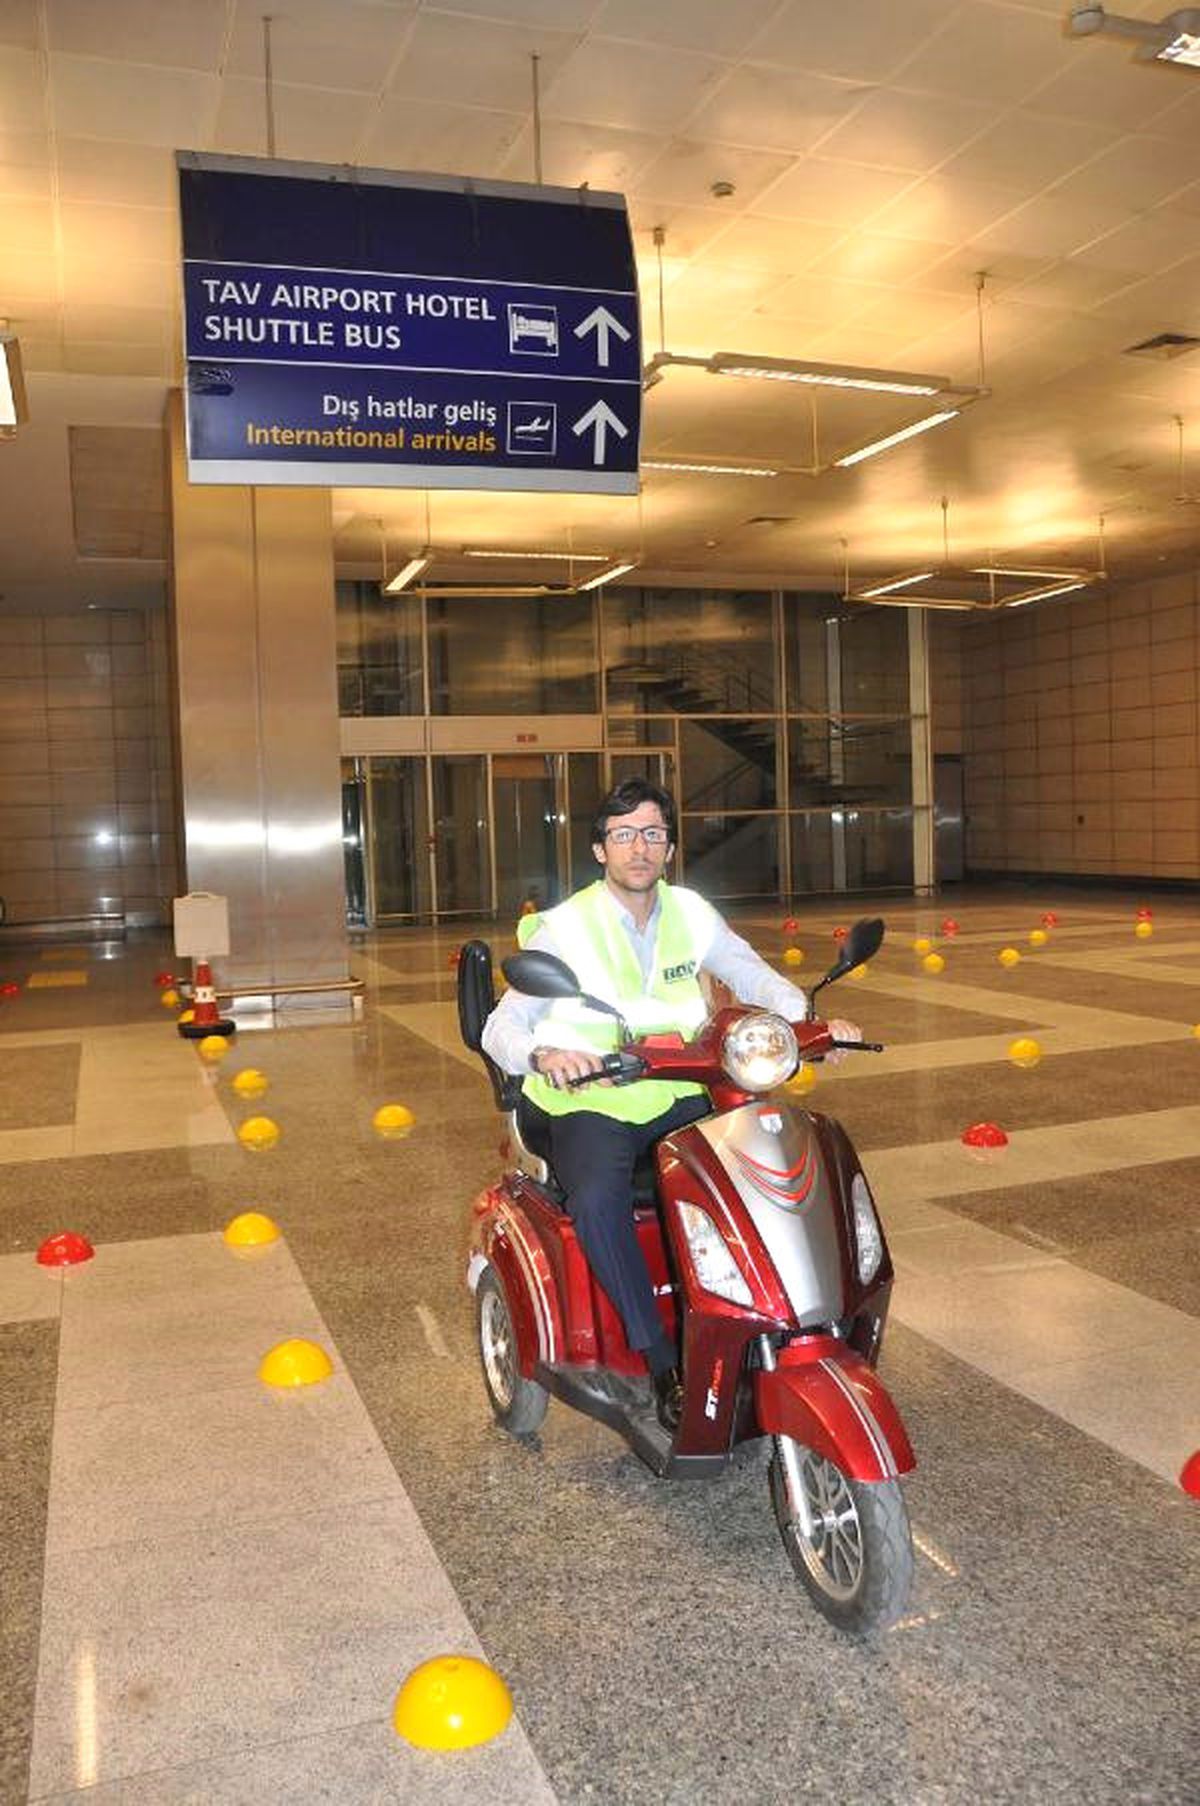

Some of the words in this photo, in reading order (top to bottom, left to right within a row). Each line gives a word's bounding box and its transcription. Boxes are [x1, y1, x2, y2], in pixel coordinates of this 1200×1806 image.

[202, 280, 261, 304] TAV
[270, 285, 397, 315] AIRPORT
[406, 293, 497, 321] HOTEL
[206, 316, 334, 346] SHUTTLE
[345, 324, 401, 350] BUS
[323, 395, 360, 420] Dış
[368, 396, 438, 420] hatlar
[444, 401, 497, 427] geliş
[246, 422, 405, 449] International
[412, 430, 496, 452] arrivals
